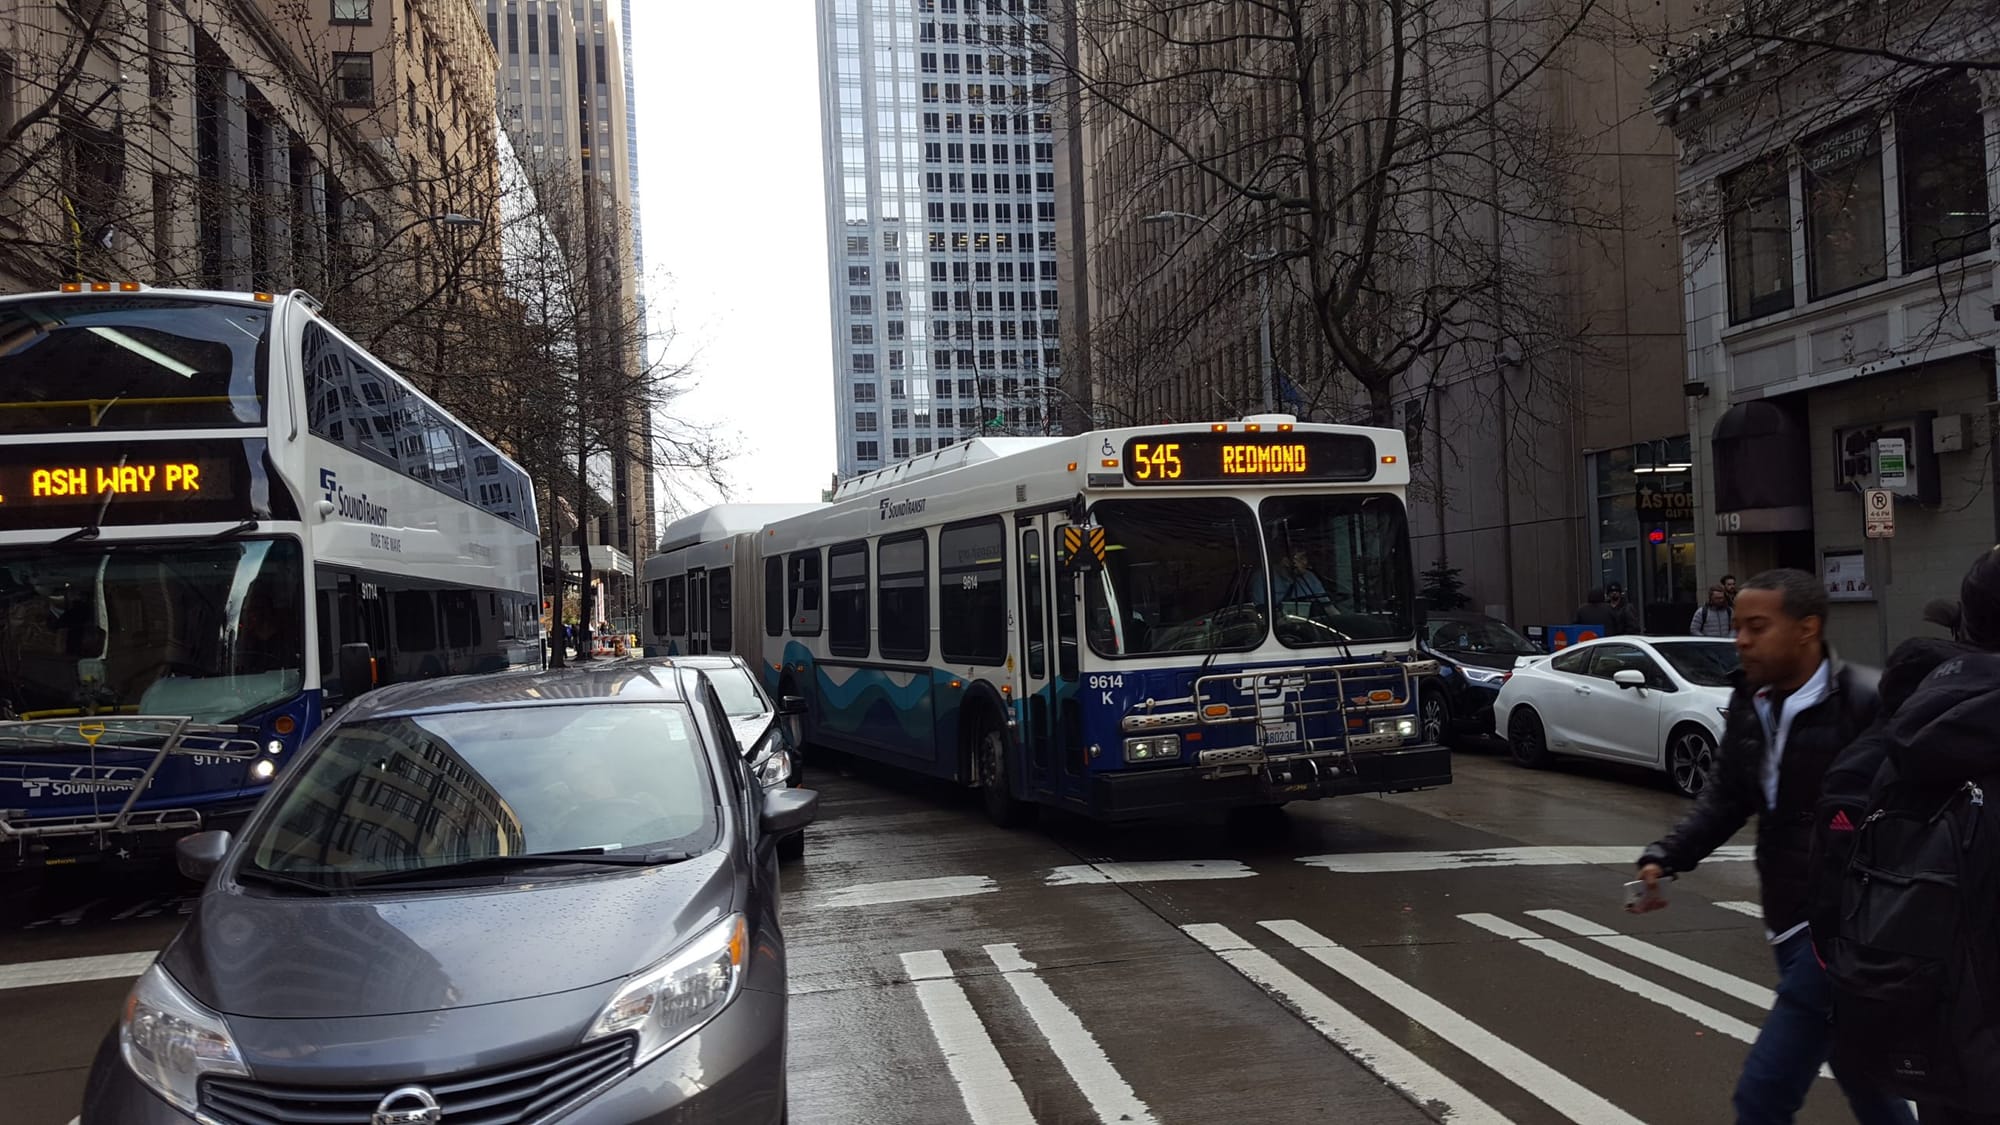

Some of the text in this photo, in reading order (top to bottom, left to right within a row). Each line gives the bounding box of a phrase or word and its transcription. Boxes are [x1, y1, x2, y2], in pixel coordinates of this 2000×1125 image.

[1135, 444, 1306, 479] 545 REDMOND
[32, 463, 199, 496] ASH WAY PR
[962, 575, 978, 590] 9614
[1089, 674, 1124, 689] 9614
[1102, 691, 1114, 705] K
